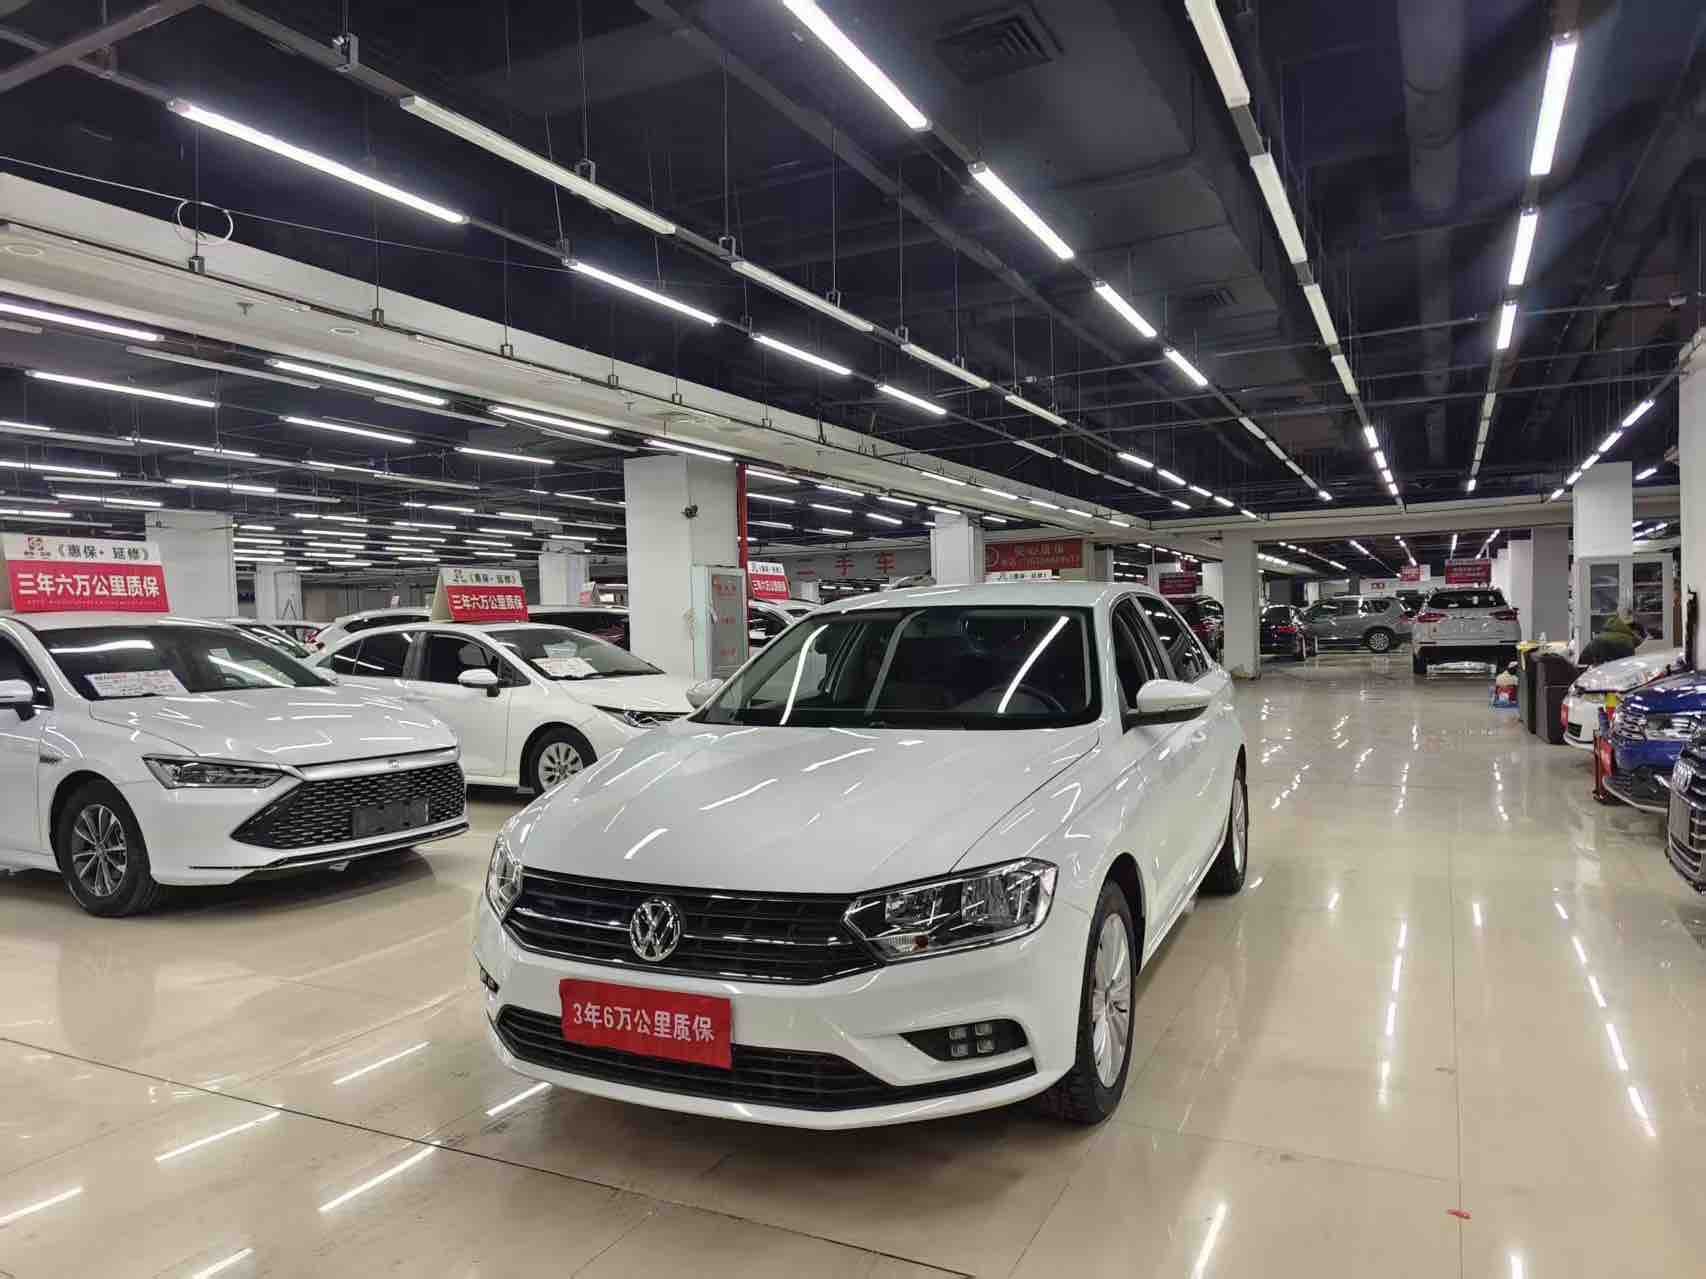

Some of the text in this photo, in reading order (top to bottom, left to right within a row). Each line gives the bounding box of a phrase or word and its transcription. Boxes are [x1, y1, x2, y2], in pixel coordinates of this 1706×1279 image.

[17, 572, 160, 598] 三年六万公里质保
[451, 594, 522, 610] 三年六万公里质保
[572, 1001, 715, 1042] 3年6万公里质保
